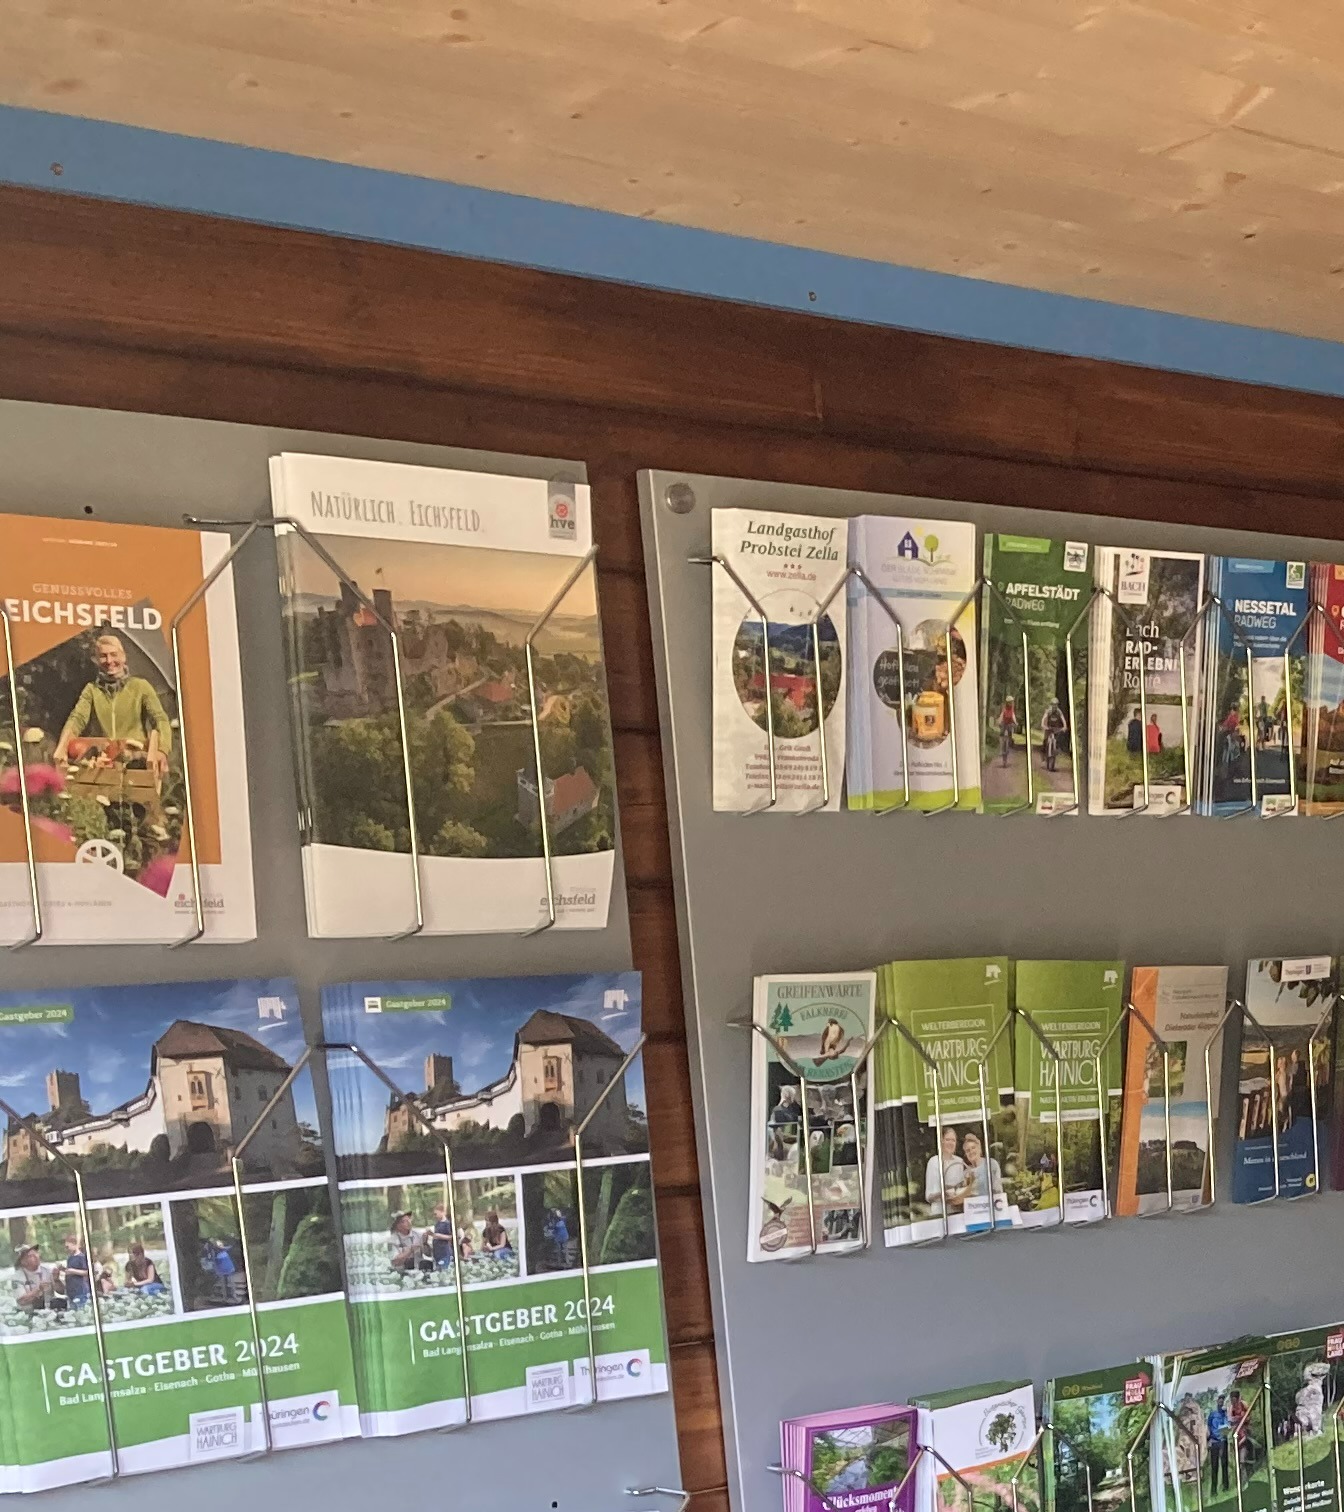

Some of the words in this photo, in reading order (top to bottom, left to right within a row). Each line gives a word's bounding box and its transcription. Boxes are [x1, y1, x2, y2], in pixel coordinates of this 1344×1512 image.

[550, 517, 575, 530] hve
[747, 520, 838, 546] Landgasthof
[740, 540, 803, 558] Probstei
[806, 546, 839, 561] Zella
[767, 570, 817, 581] www.zella.de
[32, 582, 133, 600] GENUSSVOLLES
[1006, 582, 1080, 601] APFELSTÄDT
[1121, 581, 1146, 592] BACH
[5, 597, 162, 631] EICHSFELD
[1234, 599, 1297, 617] NESSETAL
[1234, 614, 1277, 630] RADWEG
[921, 1037, 988, 1060] WARTBURG
[419, 1304, 558, 1343] GASTGEBER
[423, 1349, 440, 1358] Bad
[540, 1330, 564, 1339] Gotha
[54, 1344, 228, 1389] GASTGEBER
[59, 1396, 80, 1406] Bad
[154, 1377, 198, 1391] Eisenach
[205, 1372, 236, 1384] Gotha
